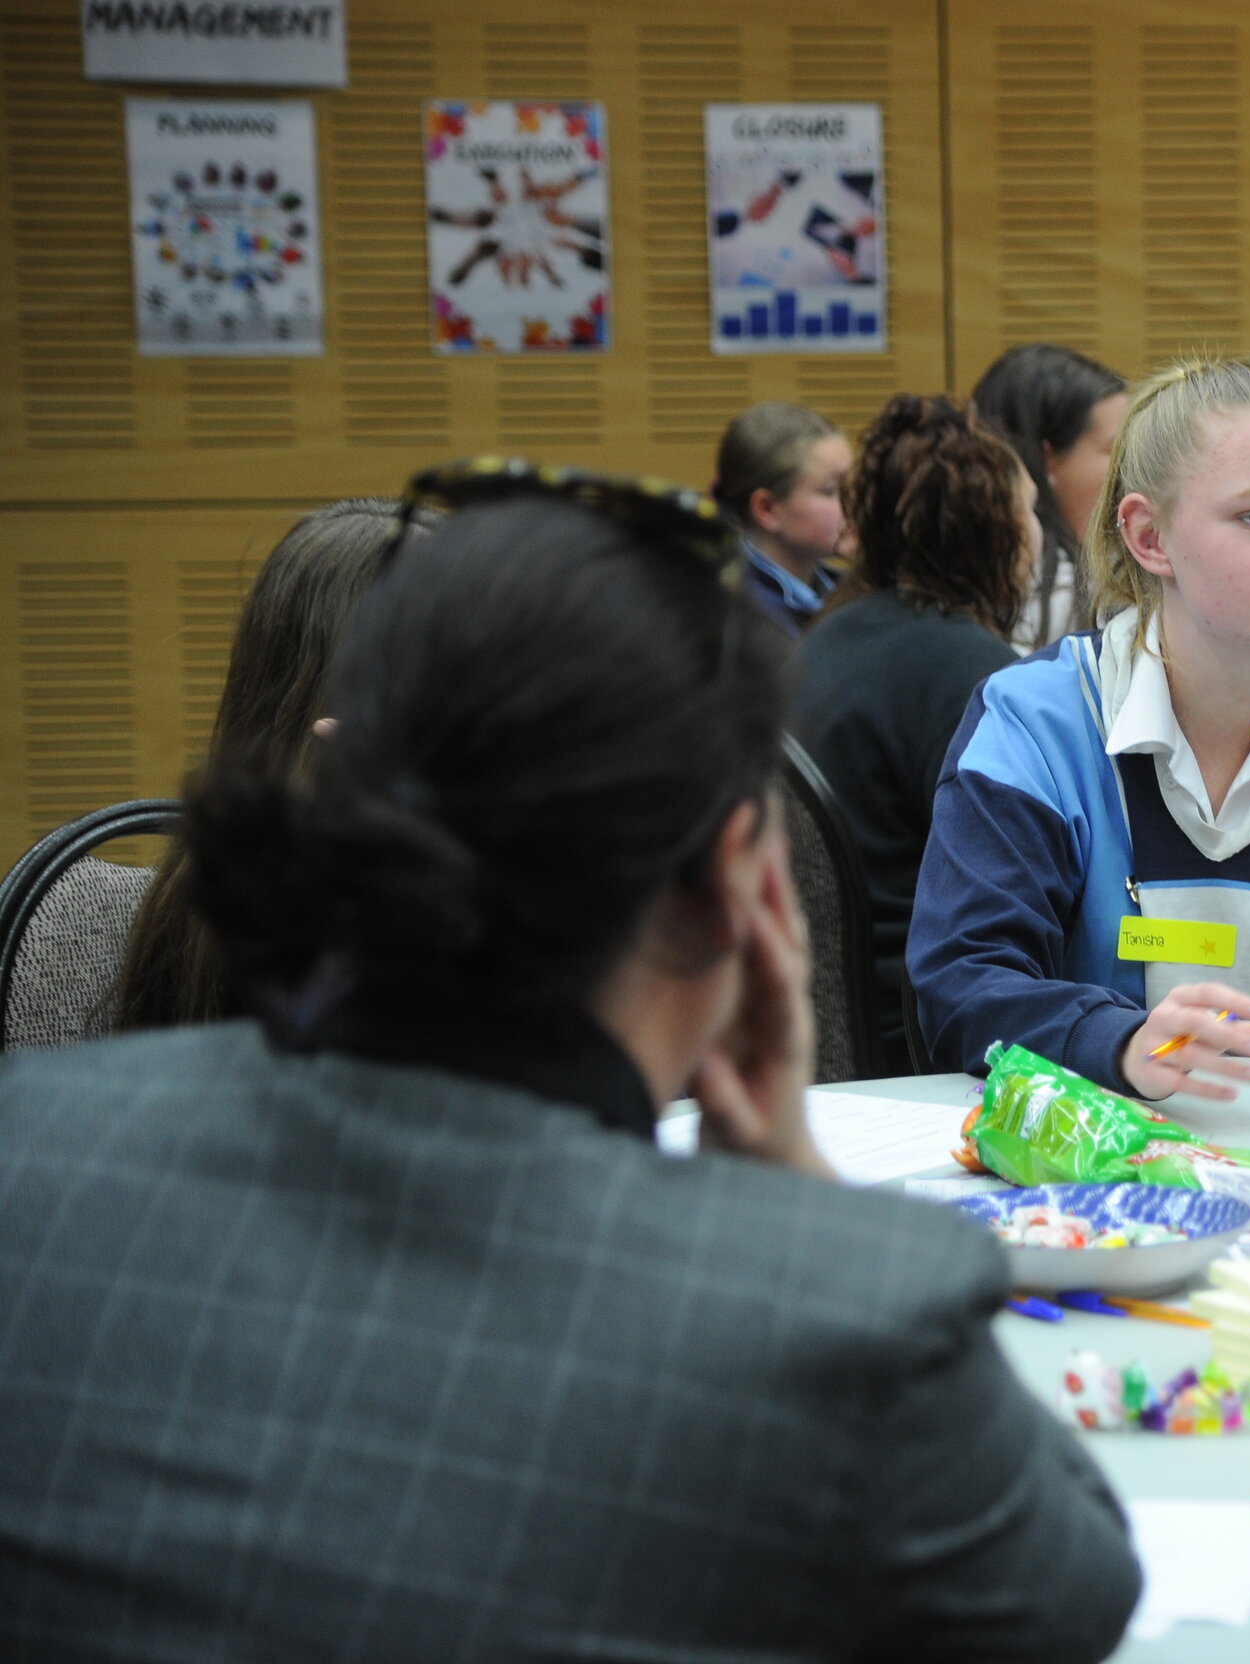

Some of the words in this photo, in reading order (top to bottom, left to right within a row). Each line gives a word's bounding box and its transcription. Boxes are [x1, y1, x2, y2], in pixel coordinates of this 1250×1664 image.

[86, 2, 332, 40] MANAGEMENT
[156, 112, 277, 136] PLANNING
[732, 112, 849, 142] CLOSURE
[1122, 931, 1165, 948] Tanisha
